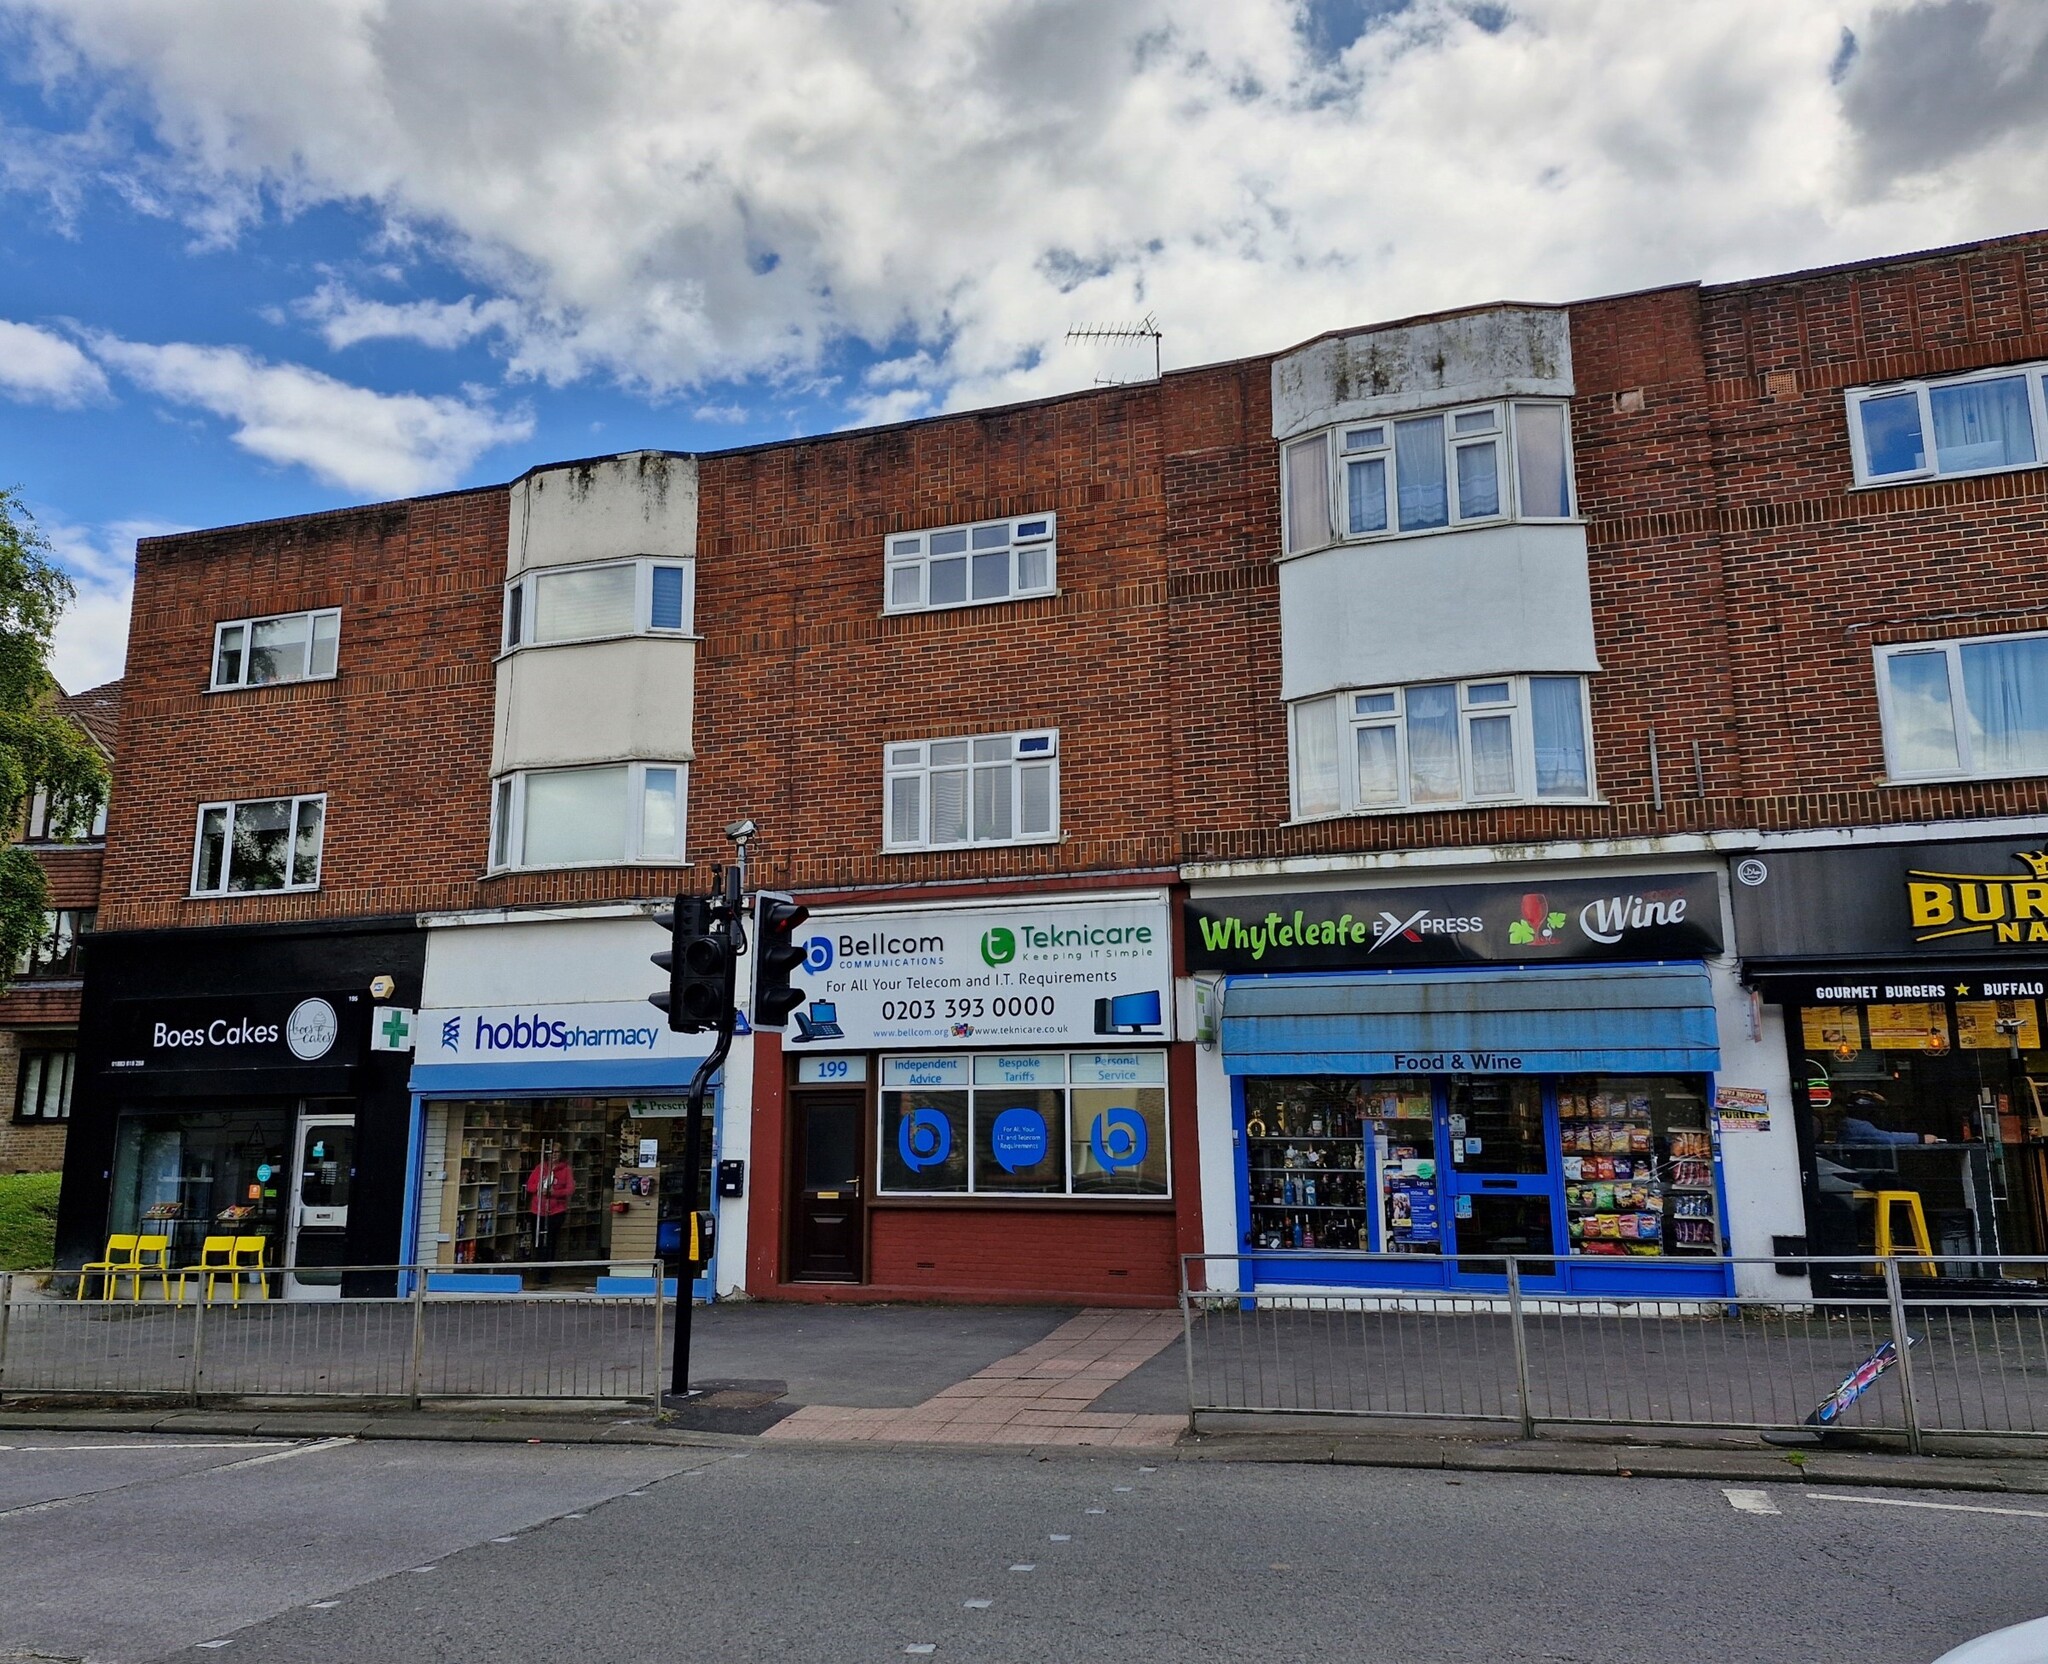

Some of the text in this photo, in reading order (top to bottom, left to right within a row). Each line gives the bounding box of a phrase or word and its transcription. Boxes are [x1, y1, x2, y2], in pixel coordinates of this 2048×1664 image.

[1580, 894, 1687, 944] Wine
[1021, 924, 1152, 948] Teknicare
[1199, 910, 1365, 960] Whyteleafe
[839, 933, 944, 957] Bellcom
[1023, 948, 1153, 961] Keeping IT Simple
[840, 957, 944, 969] COMMUNICATIONS
[827, 970, 1117, 993] For All Your Telecom and I.T. Requirements
[1816, 982, 2044, 999] GOURMET BURGERS BUFFALO
[882, 995, 1055, 1021] 0203 393 0000
[153, 1017, 279, 1047] Boes Cakes
[873, 1024, 1069, 1038] www.bellcom.org www.teknicare.co.uk
[894, 1059, 957, 1071] Independent
[998, 1058, 1040, 1069] Bespoke
[1094, 1055, 1140, 1066] Personal
[1394, 1053, 1522, 1070] Food & Wine
[818, 1060, 848, 1078] 199
[1004, 1071, 1034, 1082] Tariffs
[1098, 1070, 1136, 1081] Service
[909, 1073, 942, 1085] Advice
[1000, 1142, 1039, 1150] Requirements
